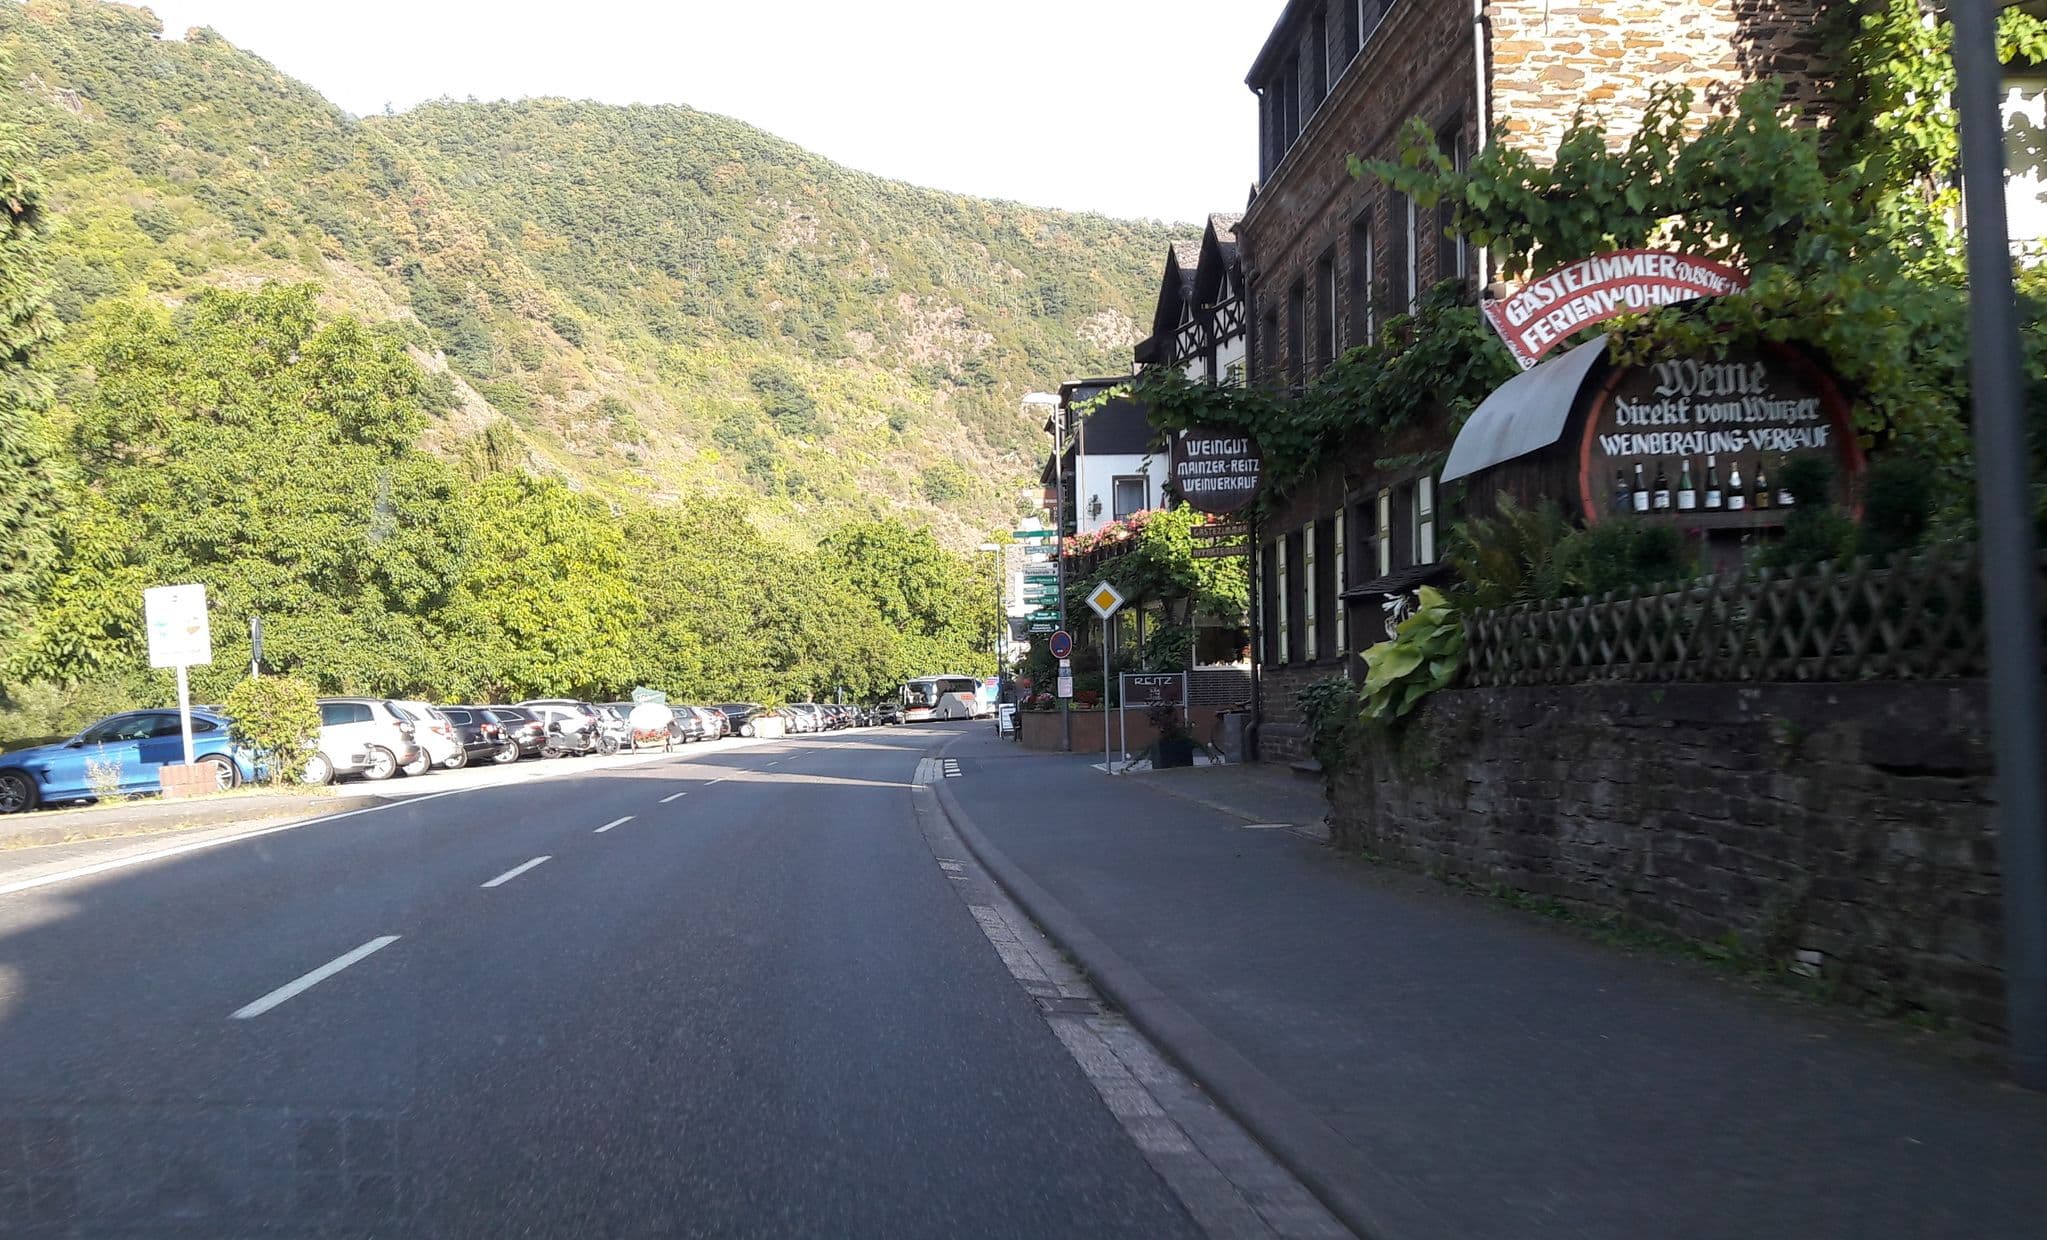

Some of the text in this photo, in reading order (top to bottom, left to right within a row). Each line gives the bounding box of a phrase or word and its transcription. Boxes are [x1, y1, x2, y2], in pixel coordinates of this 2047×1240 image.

[1650, 358, 1770, 397] Weine
[1615, 396, 1691, 426] direkt
[1694, 402, 1742, 423] vom
[1186, 438, 1248, 456] WEINGUT
[1177, 458, 1260, 476] MAINZER-REITZ
[1182, 475, 1258, 492] WEINVERKAUF
